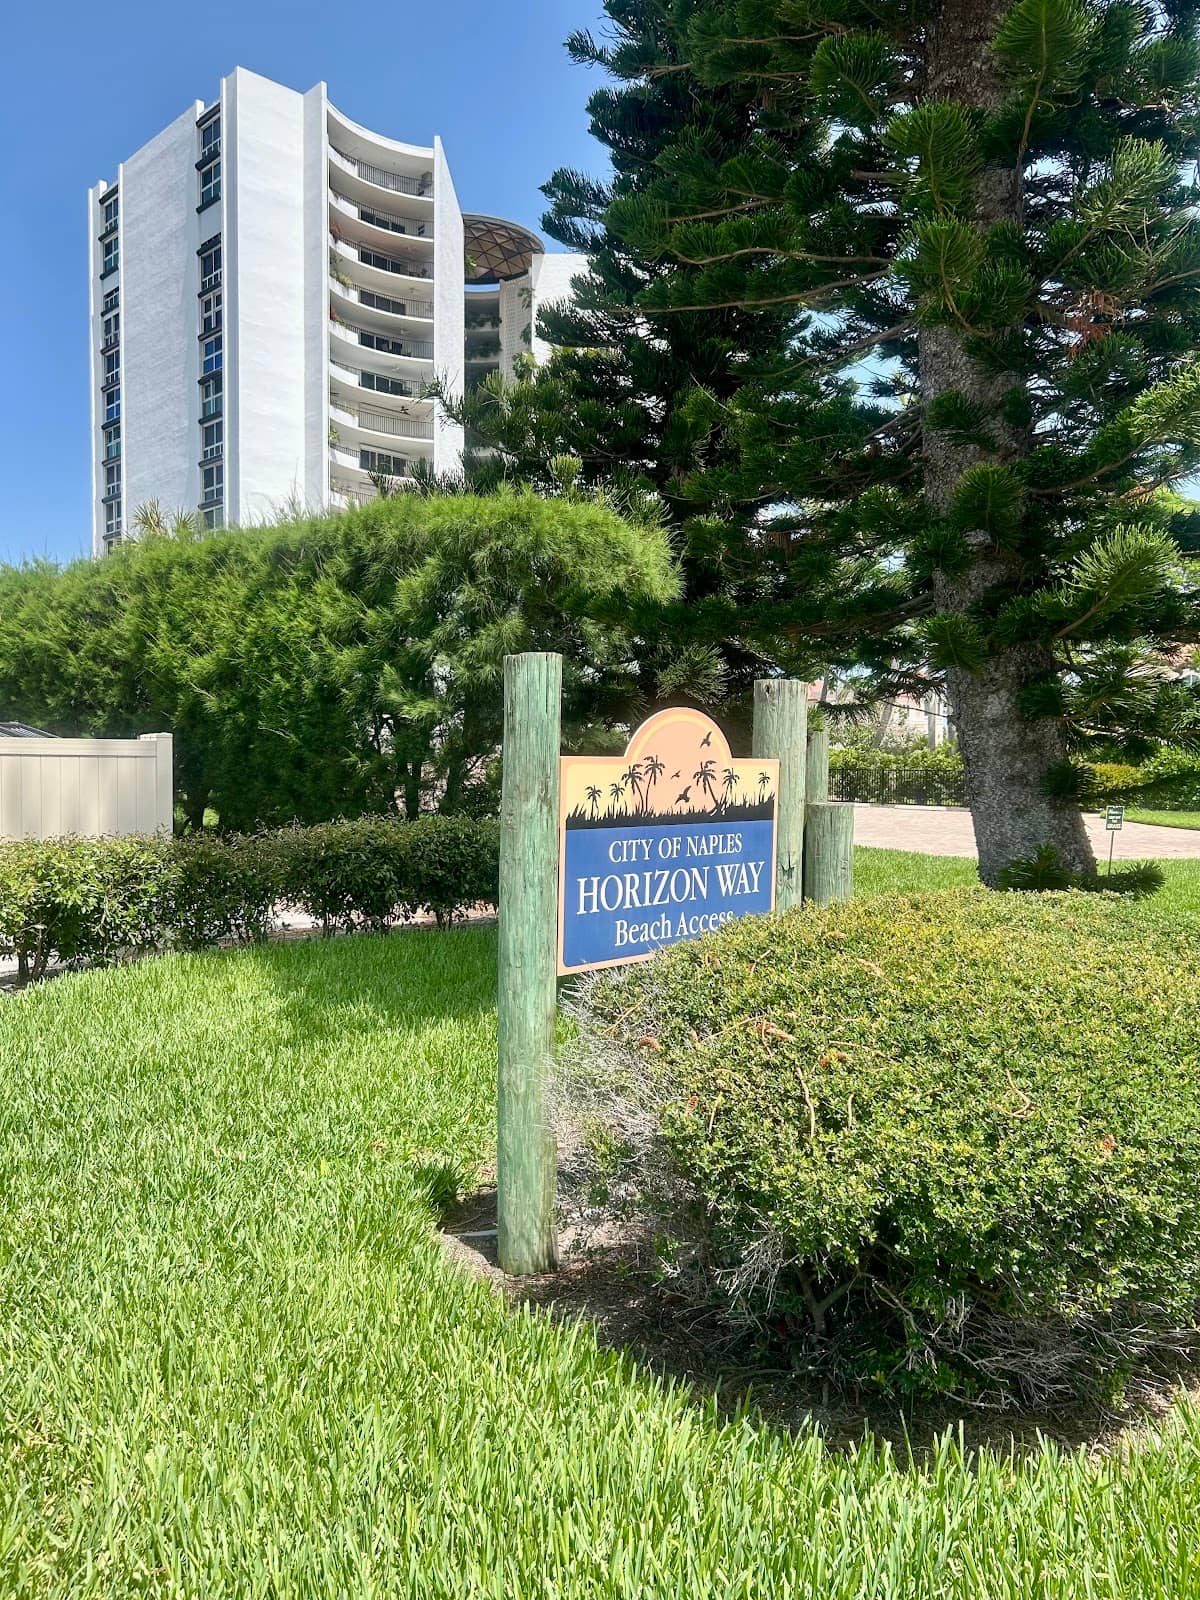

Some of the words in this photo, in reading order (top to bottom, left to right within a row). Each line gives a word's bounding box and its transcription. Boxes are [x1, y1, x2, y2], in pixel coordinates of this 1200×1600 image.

[608, 838, 654, 863] CITY
[658, 836, 682, 859] OF
[686, 832, 743, 857] NAPLES
[576, 866, 709, 915] HORIZON
[715, 861, 765, 898] WAY
[614, 912, 673, 947] Beach
